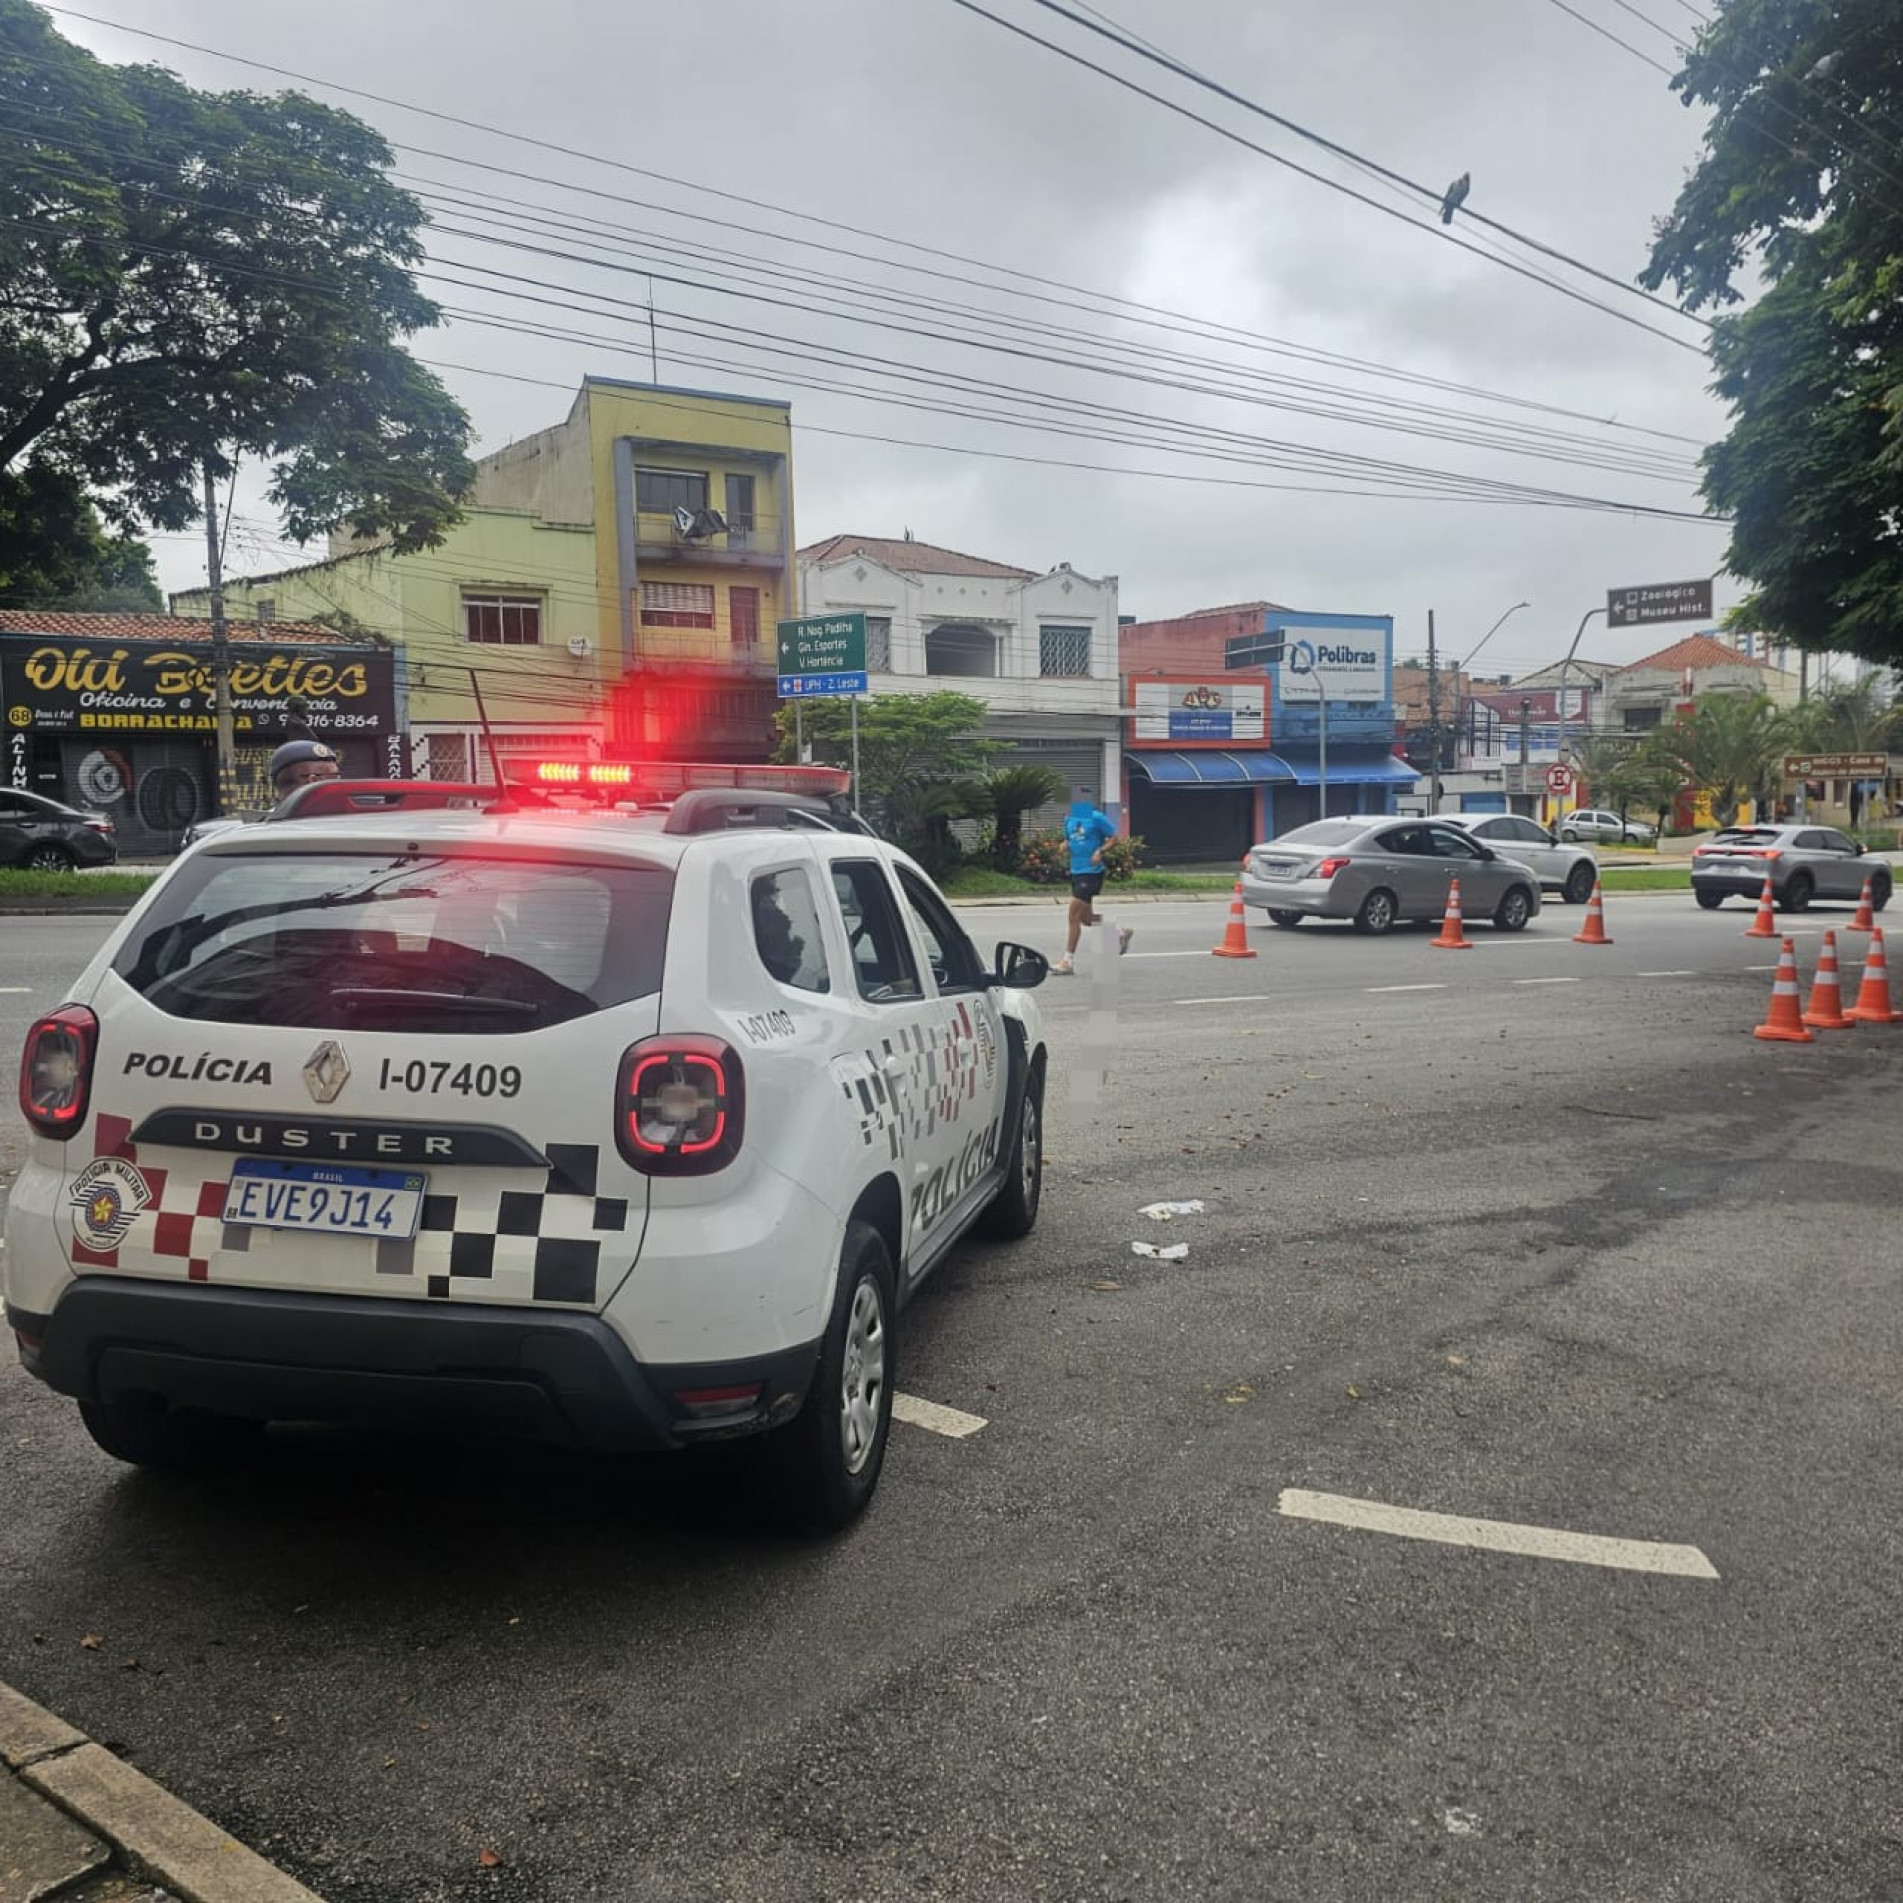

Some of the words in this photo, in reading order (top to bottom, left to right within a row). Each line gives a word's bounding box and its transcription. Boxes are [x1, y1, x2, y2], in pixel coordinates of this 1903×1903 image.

[25, 647, 130, 691] Old
[1318, 644, 1376, 664] Polibras
[80, 691, 167, 708] Oficina
[179, 697, 192, 708] e
[737, 1009, 796, 1044] I-07409
[122, 1051, 272, 1086] POLÍCIA
[380, 1058, 522, 1098] I-07409
[195, 1123, 453, 1155] DUSTER
[115, 1163, 145, 1201] MILITAR
[312, 1170, 344, 1183] BRASIL
[239, 1181, 395, 1230] EVE9J14
